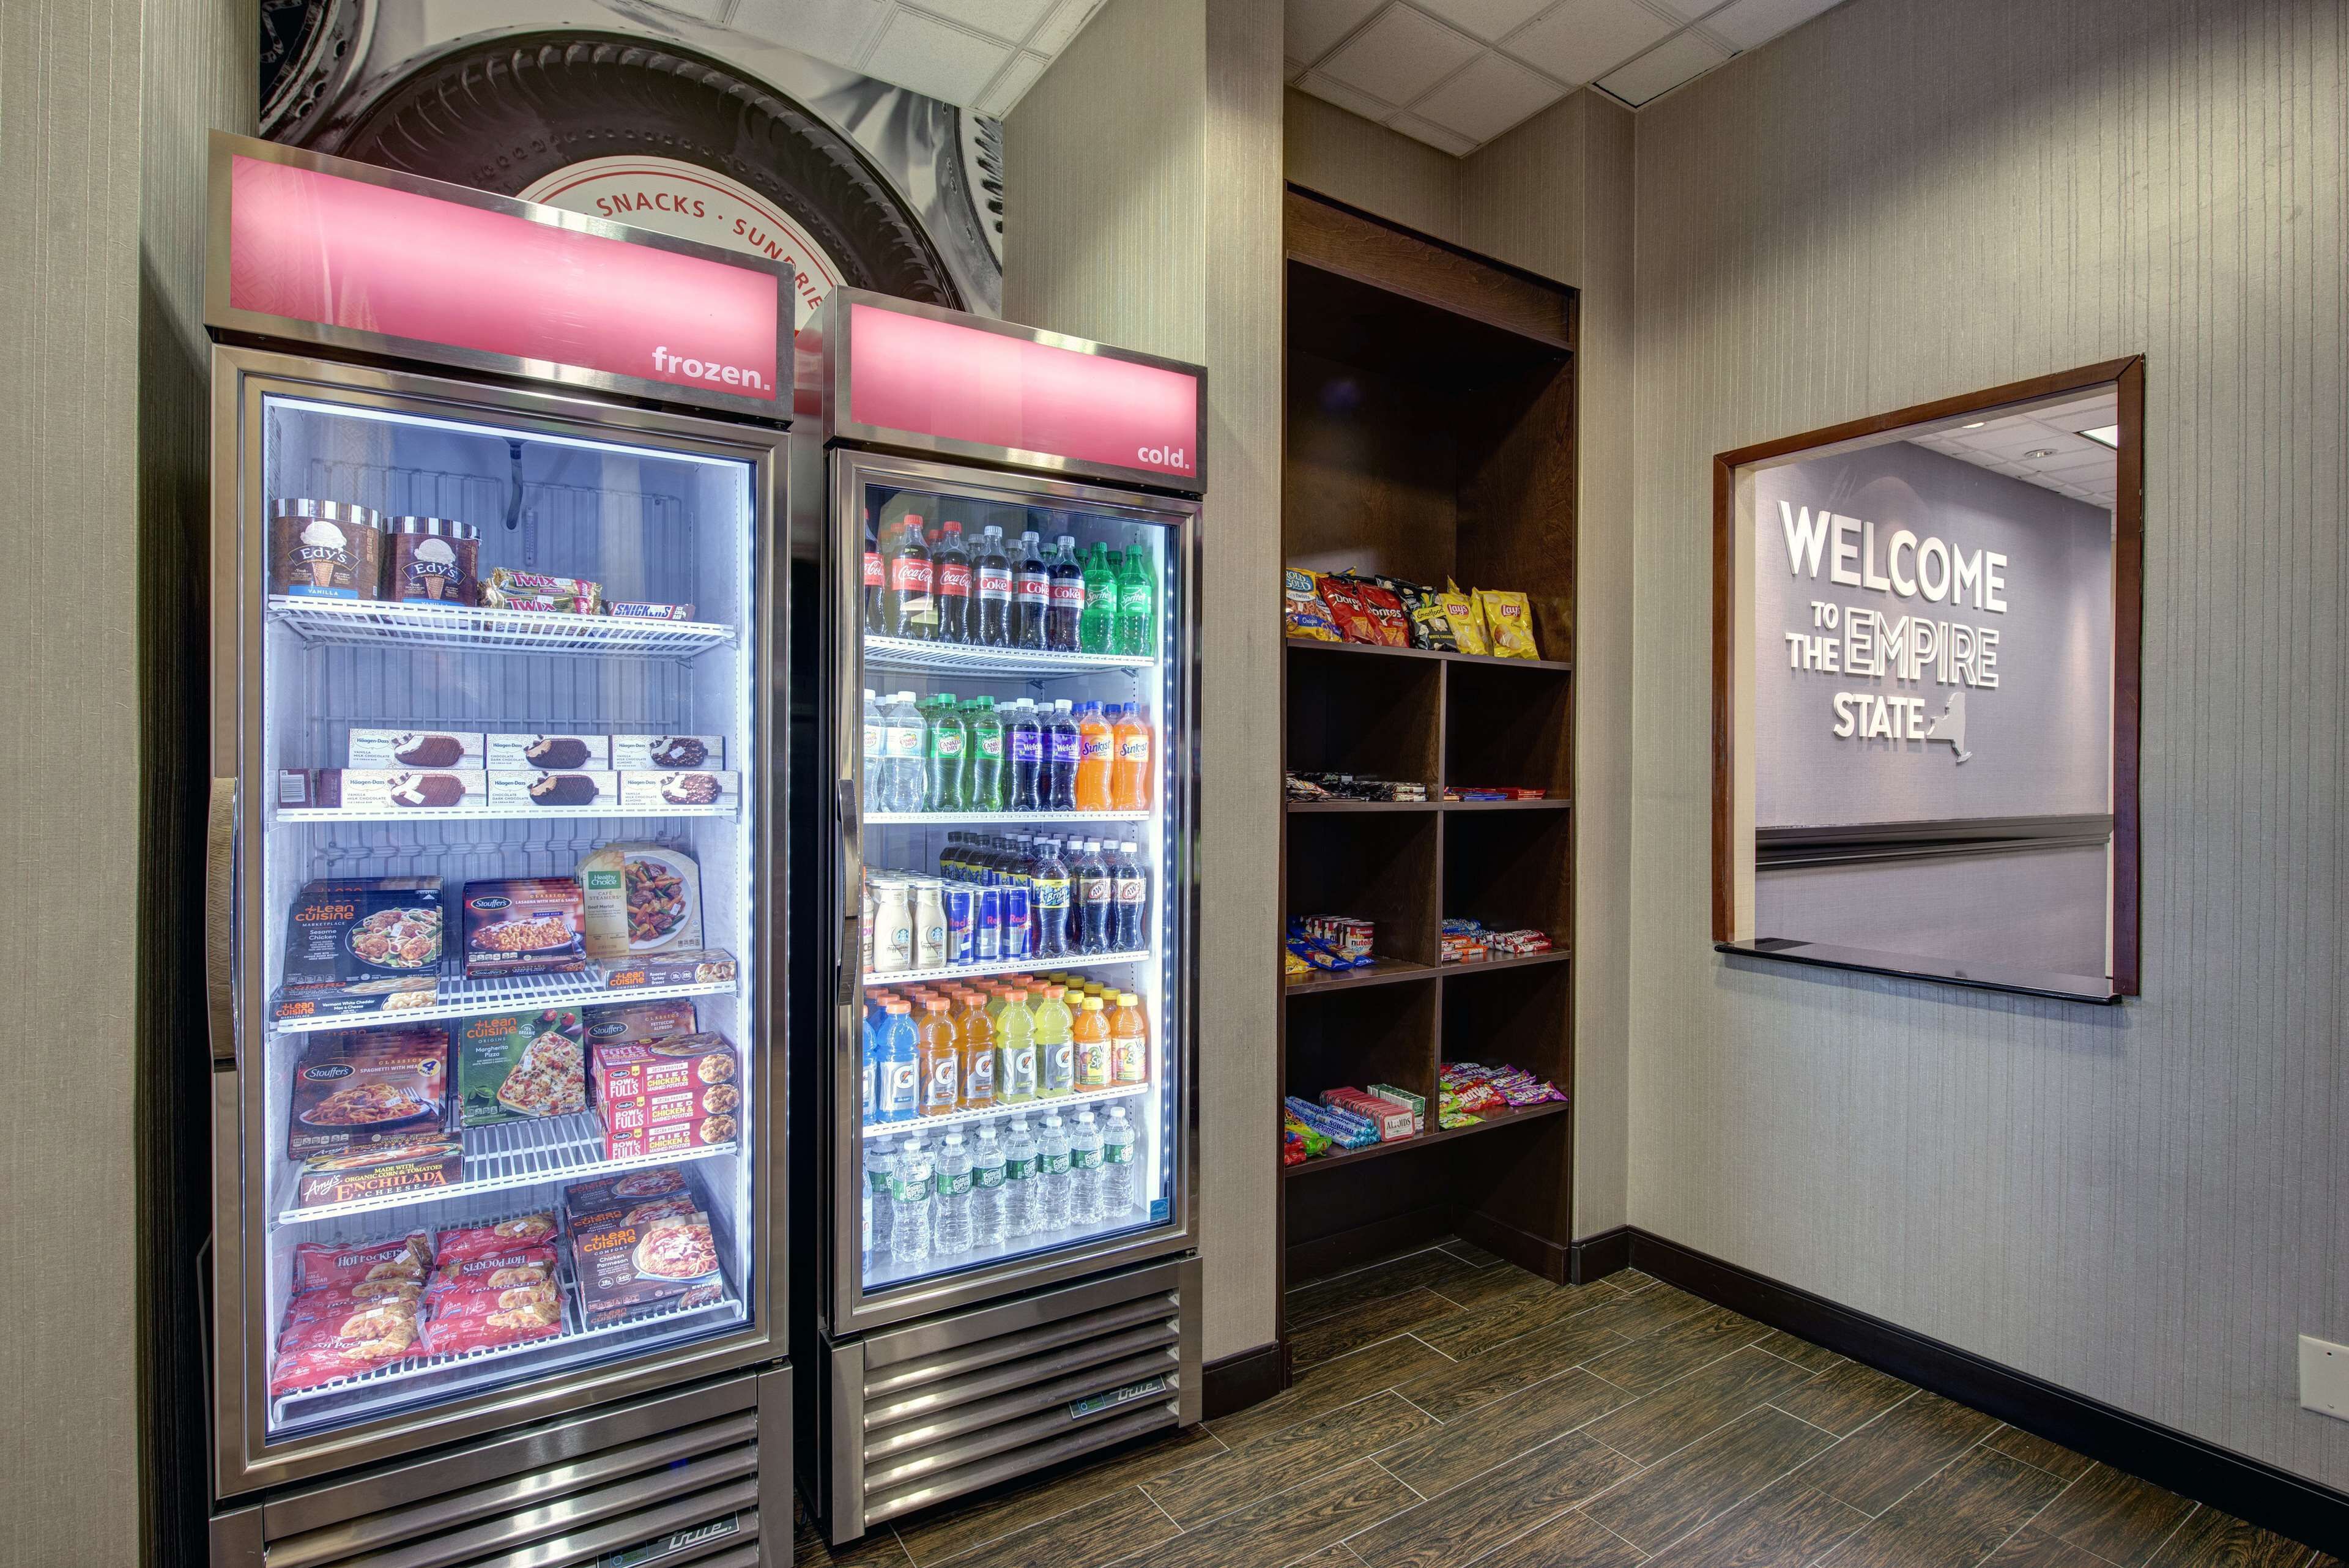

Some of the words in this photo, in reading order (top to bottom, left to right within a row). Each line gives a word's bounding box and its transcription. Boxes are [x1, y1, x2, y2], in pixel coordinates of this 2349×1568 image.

[596, 192, 706, 218] SNACKS
[732, 218, 823, 310] SUNRIE
[651, 346, 771, 392] frozen.
[1138, 445, 1190, 470] cold.
[301, 546, 347, 565] Edy's
[1777, 500, 2008, 613] WELCOME
[414, 562, 456, 579] Edy's
[898, 564, 933, 583] Coca-Cola
[940, 570, 973, 589] Coca-Cola
[980, 578, 1008, 591] Coke
[308, 588, 338, 596] VANILLA
[1026, 581, 1050, 596] Coke
[1054, 587, 1080, 599] Coke
[1086, 591, 1111, 601] Sprite
[1122, 592, 1145, 604] Sprite
[1416, 607, 1444, 619] Smartfood
[1449, 604, 1468, 616] Lay's
[1502, 604, 1521, 617] Lay's
[1811, 600, 1839, 630] TO
[1785, 632, 1840, 672] THE
[1844, 606, 1999, 688] EMPIRE
[1833, 692, 1925, 739] STATE
[1082, 740, 1112, 756] Sunkist
[1119, 741, 1148, 756] Sunkist
[475, 899, 507, 909] Stouffer's
[593, 1024, 623, 1034] Stouffer's
[422, 1060, 437, 1072] 4
[310, 1066, 349, 1079] Stouffer's
[647, 1070, 688, 1081] FRIED
[647, 1076, 681, 1087] CHICKEN
[610, 1083, 639, 1099] FULLS
[651, 1100, 694, 1111] FRIED
[652, 1106, 686, 1118] CHICKEN
[615, 1114, 644, 1131] FULLS
[1386, 1117, 1411, 1130] ALOIDS
[648, 1131, 691, 1142] FRIED
[649, 1137, 683, 1148] CHICKEN
[612, 1145, 641, 1160] FULLS
[1053, 1155, 1069, 1165] Poland
[374, 1165, 395, 1174] MADE
[1053, 1161, 1069, 1172] Spring
[344, 1172, 377, 1183] ORGANIC
[378, 1169, 399, 1178] CORN
[406, 1164, 443, 1175] TOMATOES
[983, 1169, 1001, 1179] Poland
[953, 1175, 970, 1186] Poland
[984, 1175, 1001, 1185] Spring
[303, 1174, 343, 1202] Amy's
[335, 1170, 449, 1203] ENCHILADA
[364, 1183, 421, 1197] CHEESE
[905, 1182, 925, 1192] Poland
[954, 1181, 971, 1192] Spring
[906, 1188, 926, 1199] Spring
[594, 1246, 628, 1255] COMFORT
[338, 1255, 358, 1267] HOT
[507, 1254, 526, 1265] HOT
[596, 1258, 628, 1268] Parmesan
[599, 1254, 625, 1263] Chicken
[462, 1258, 505, 1274] POCKETS
